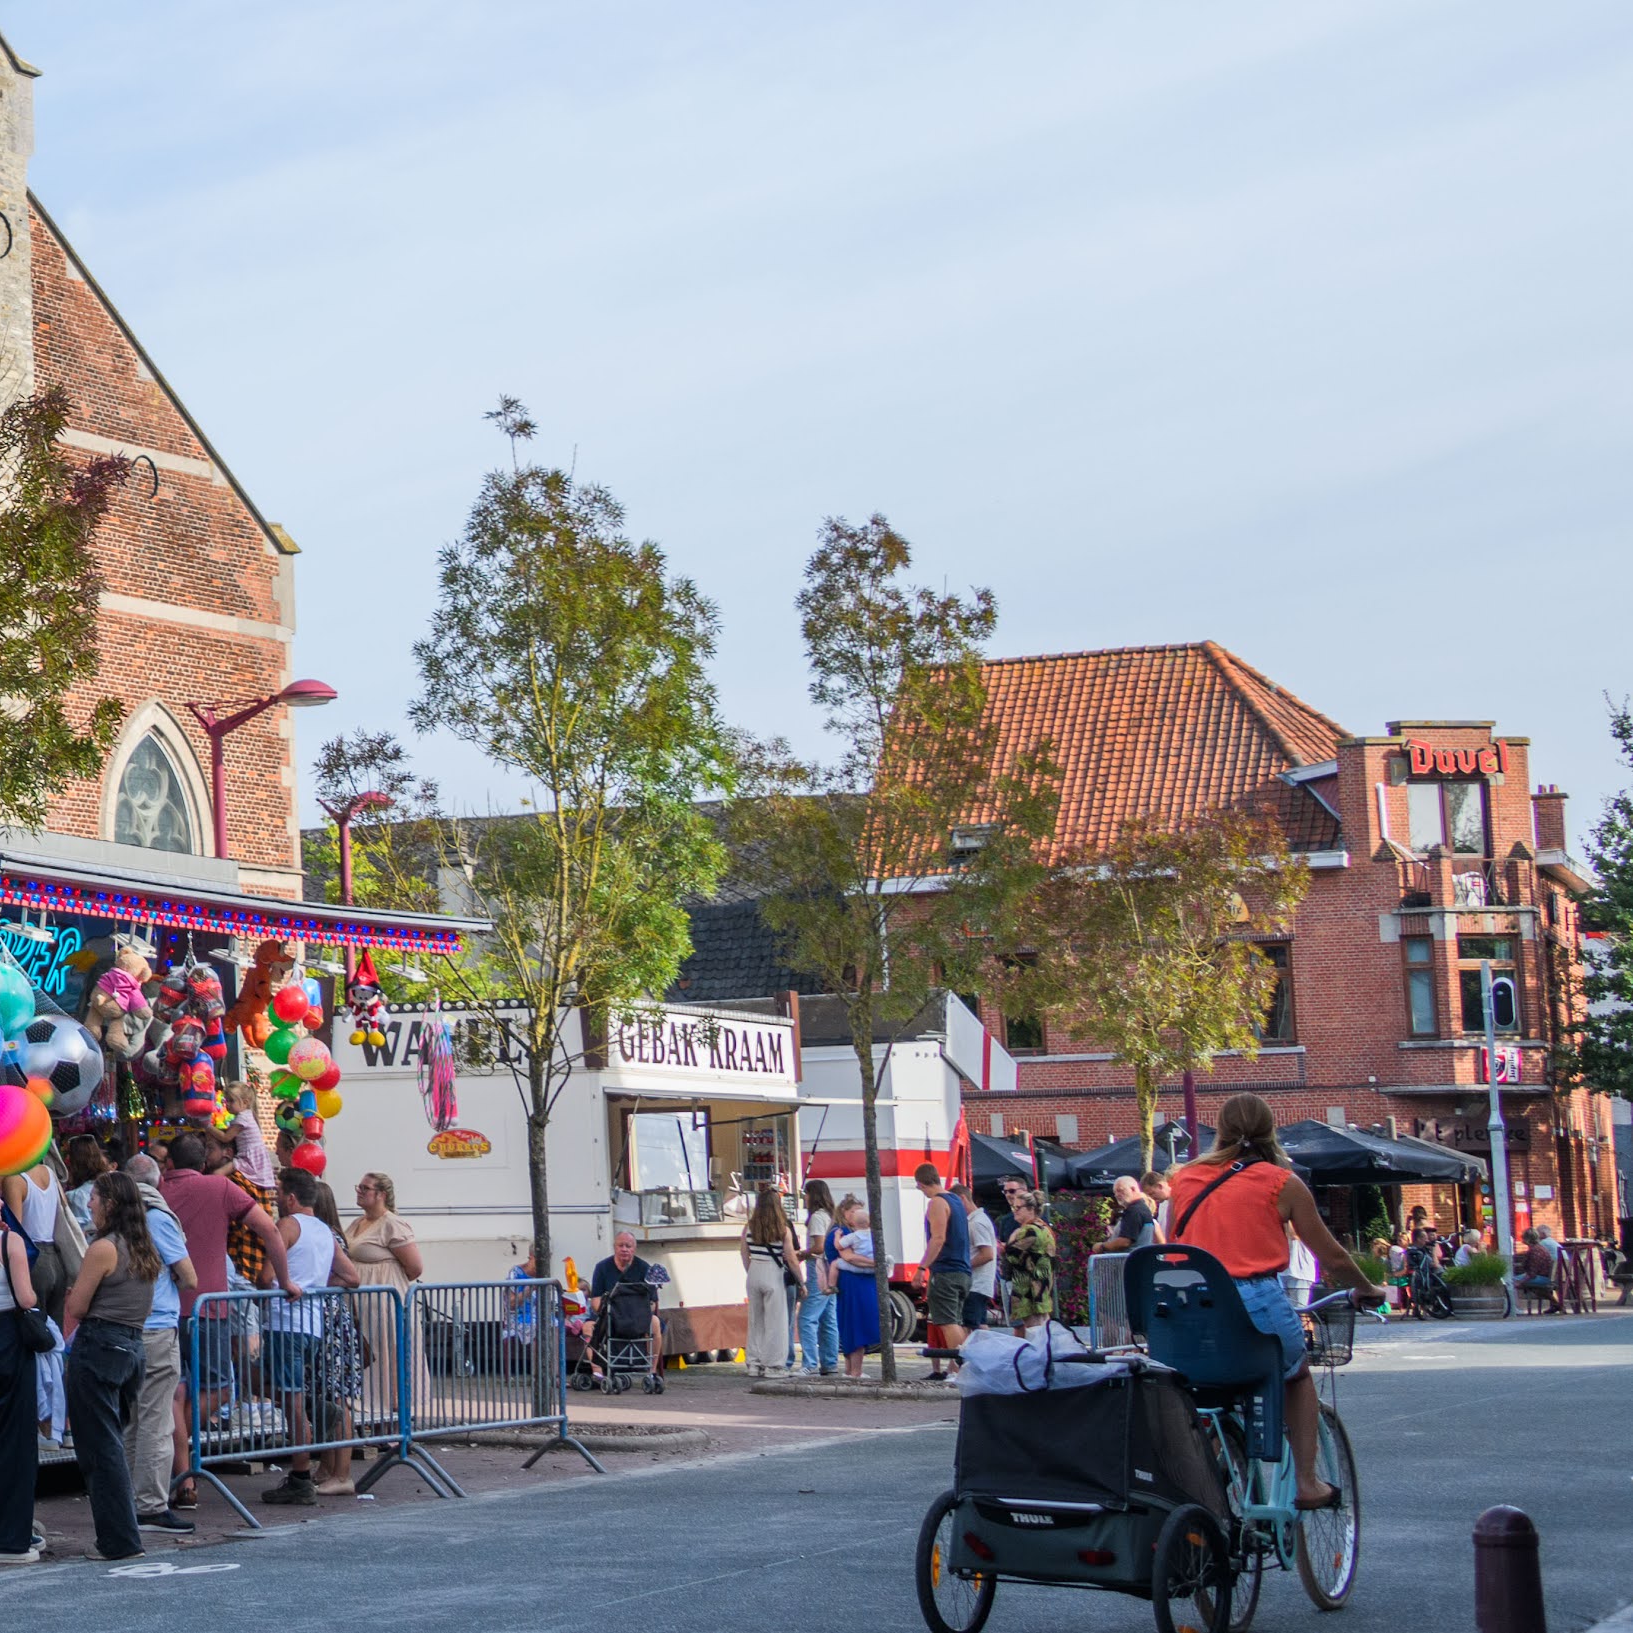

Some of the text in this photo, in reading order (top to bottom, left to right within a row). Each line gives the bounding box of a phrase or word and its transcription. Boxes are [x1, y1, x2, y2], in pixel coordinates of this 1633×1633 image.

[1408, 739, 1510, 774] Duvel
[619, 1019, 785, 1074] GEBAK KRAAM
[1010, 1512, 1054, 1524] THULE
